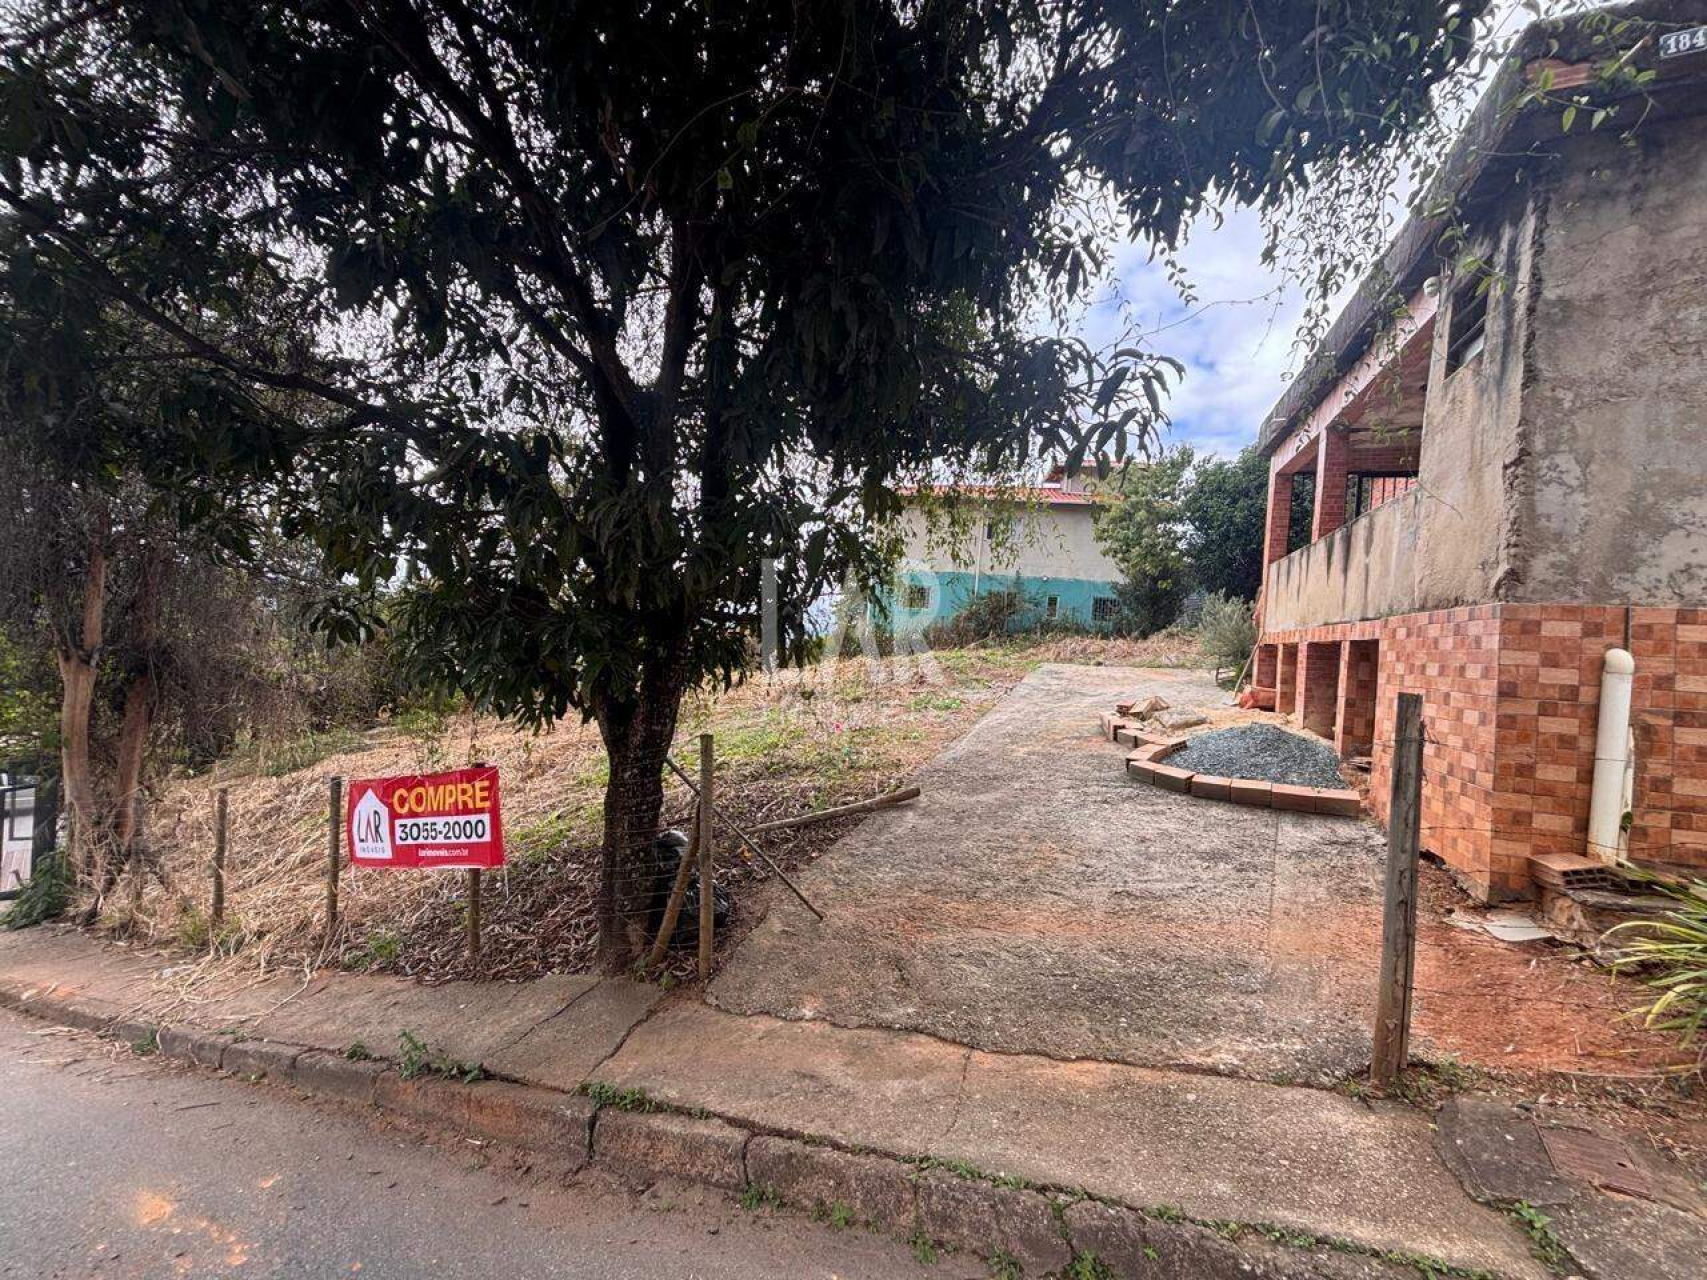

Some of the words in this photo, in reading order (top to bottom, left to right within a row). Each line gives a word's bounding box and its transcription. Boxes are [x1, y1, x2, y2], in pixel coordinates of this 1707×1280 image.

[1666, 28, 1706, 54] 184
[392, 780, 491, 813] COMPRE
[357, 810, 384, 843] LAR
[399, 819, 486, 841] 3055-2000
